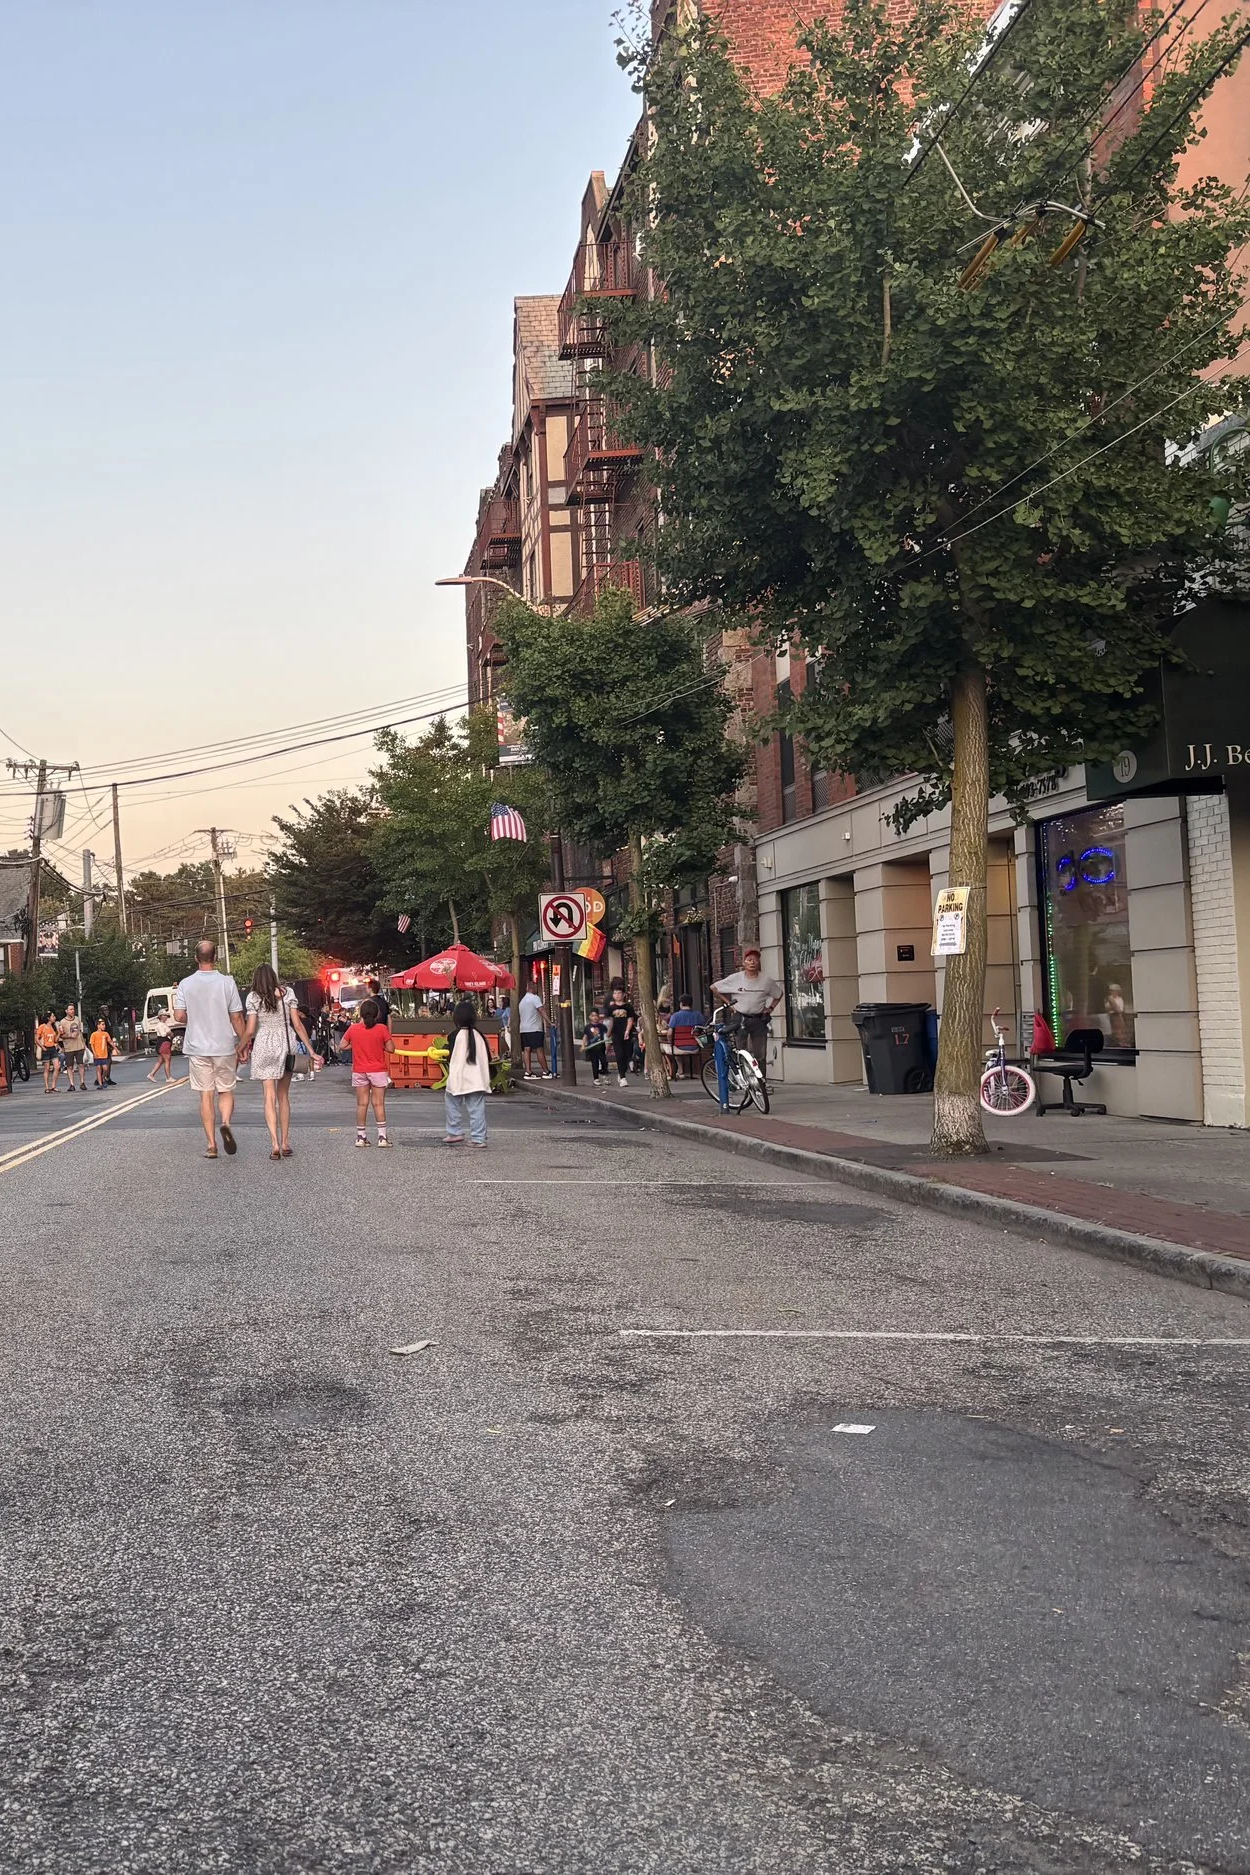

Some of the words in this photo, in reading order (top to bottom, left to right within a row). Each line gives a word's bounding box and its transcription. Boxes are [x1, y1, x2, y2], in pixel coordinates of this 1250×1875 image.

[1185, 743, 1218, 771] J.J.
[946, 893, 955, 902] NO
[937, 902, 963, 914] PARKING
